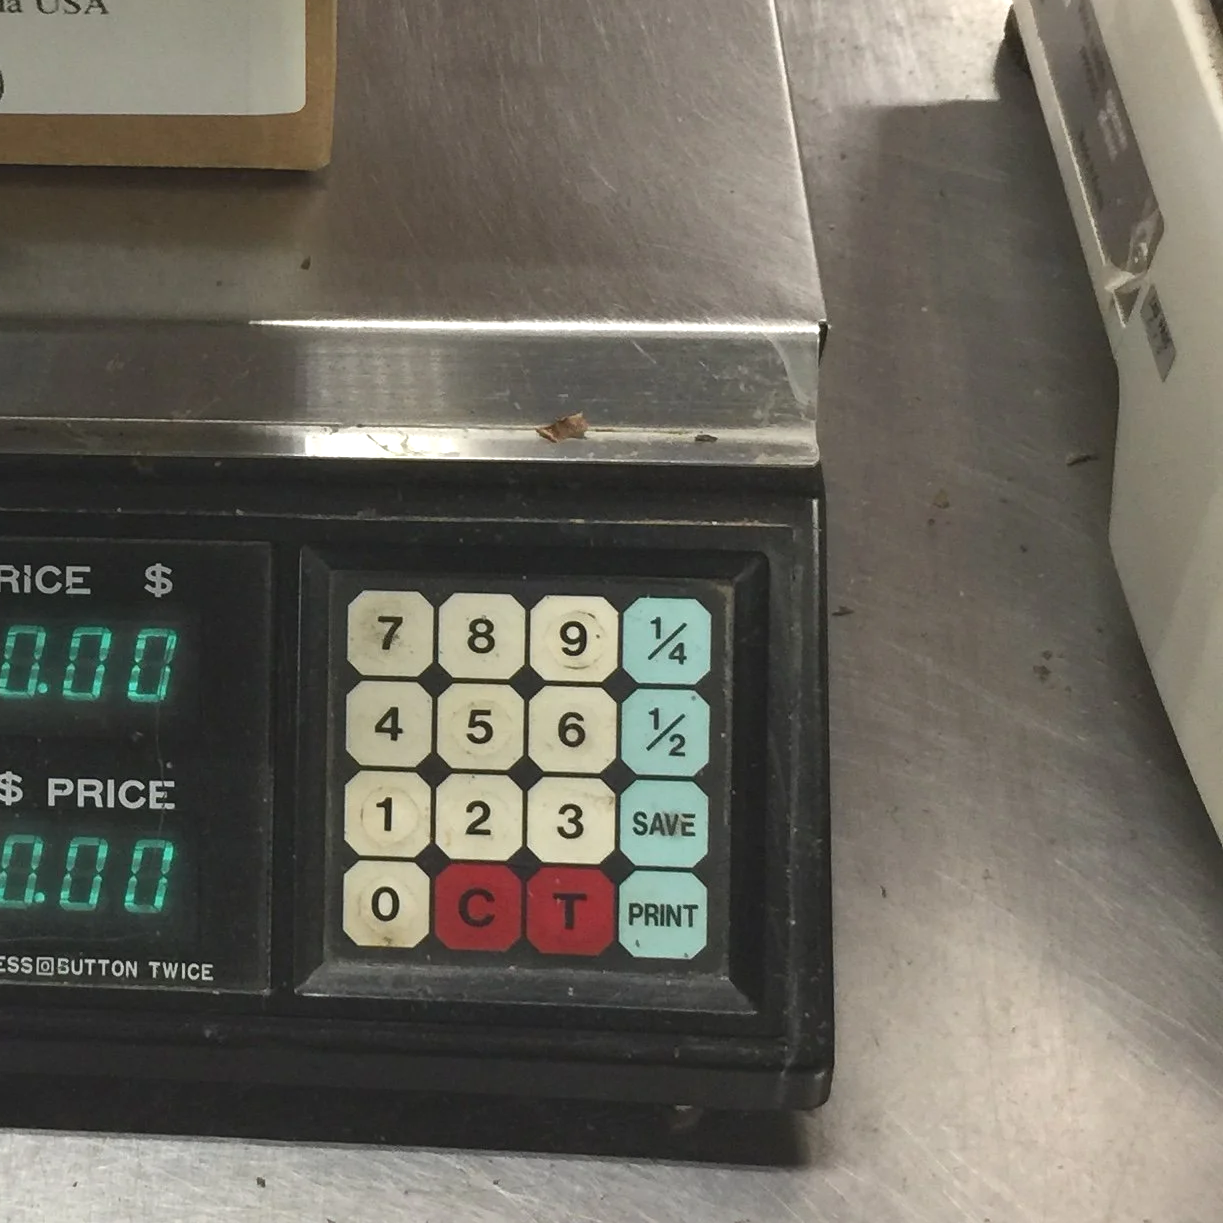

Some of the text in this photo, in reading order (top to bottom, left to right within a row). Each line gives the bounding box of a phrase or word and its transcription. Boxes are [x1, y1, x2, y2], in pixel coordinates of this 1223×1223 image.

[144, 562, 174, 597] $
[377, 616, 403, 651] 7
[466, 618, 496, 654] 8
[558, 621, 588, 656] 9
[375, 706, 403, 742] 4
[466, 709, 494, 745] 5
[557, 711, 586, 748] 6
[47, 777, 176, 810] PRICE
[376, 797, 393, 832] 1
[465, 800, 492, 836] 2
[556, 803, 584, 839] 3
[632, 811, 697, 838] SAVE
[371, 886, 400, 922] 0
[458, 888, 496, 928] C
[553, 893, 587, 930] T
[628, 903, 699, 928] PRINT
[57, 957, 138, 979] BUTTON
[148, 961, 213, 981] TWICE
